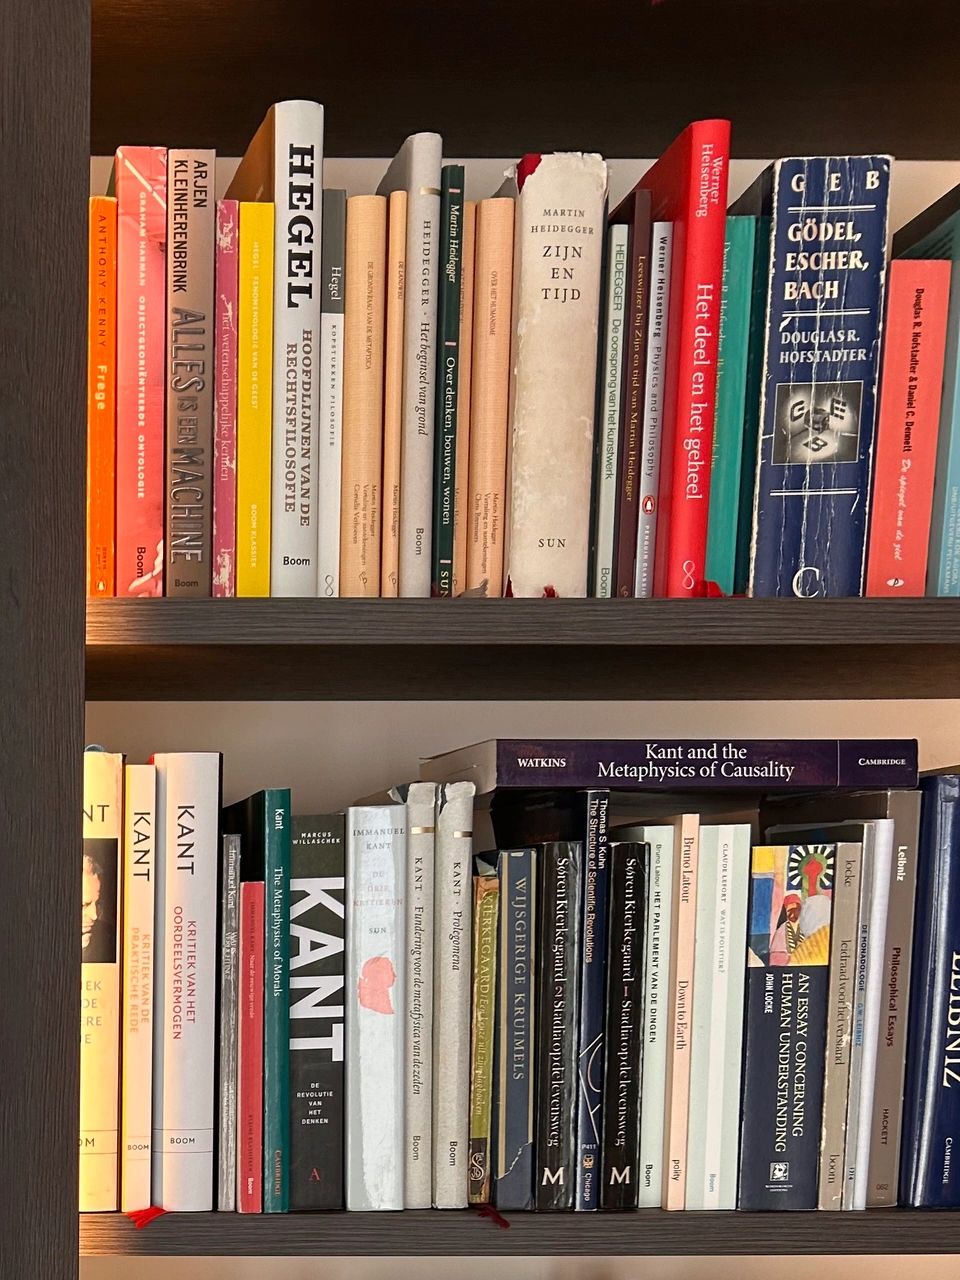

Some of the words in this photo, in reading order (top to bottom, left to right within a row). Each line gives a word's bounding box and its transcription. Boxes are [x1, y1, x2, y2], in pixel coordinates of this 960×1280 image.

[194, 159, 208, 208] ARJEN
[693, 142, 714, 218] Heisenberg
[708, 154, 724, 205] Werner
[174, 159, 187, 294] KLEINHERENBRINK
[287, 144, 315, 308] HEGEL
[531, 225, 594, 235] HEIDEGGER
[543, 208, 585, 218] MARTIN
[788, 218, 862, 242] GÖDEL,
[96, 213, 108, 288] ANTHONY
[543, 245, 583, 258] ZIJN
[785, 252, 869, 272] ESCHER,
[330, 267, 341, 300] Hegel
[551, 266, 573, 279] EN
[784, 281, 839, 299] BACH
[542, 288, 581, 300] TIJD
[96, 296, 107, 348] KENNY
[781, 330, 845, 344] DOUGLAS
[846, 330, 860, 343] R.
[779, 348, 867, 363] HOFSTADTER
[93, 363, 108, 411] Frege
[538, 539, 566, 548] SUN
[518, 757, 566, 768] WATKINS
[645, 743, 684, 761] Kant
[688, 743, 718, 761] and
[723, 743, 747, 761] the
[597, 761, 698, 782] Metaphysics
[700, 762, 718, 779] of
[720, 761, 796, 782] Causality
[132, 811, 151, 882] KANT
[177, 805, 195, 875] KANT
[895, 844, 909, 882] Leibniz
[652, 889, 662, 910] HET
[509, 875, 527, 985] WIJSGERIGE
[650, 911, 661, 969] PARLEMENT
[290, 876, 345, 1061] KANT
[649, 970, 659, 991] VAN
[763, 971, 775, 992] JOHN
[796, 971, 811, 994] AN
[886, 945, 902, 1012] Philosophical
[648, 991, 658, 1006] DE
[762, 990, 774, 1014] LOCKE
[778, 971, 794, 1029] HUMAN
[647, 1006, 658, 1044] DINGEN
[794, 996, 809, 1038] ESSAY
[883, 1013, 898, 1048] Essays
[511, 992, 526, 1081] KRUIMELS
[773, 1030, 791, 1153] UNDERSTANDING
[790, 1039, 808, 1138] CONCERNING
